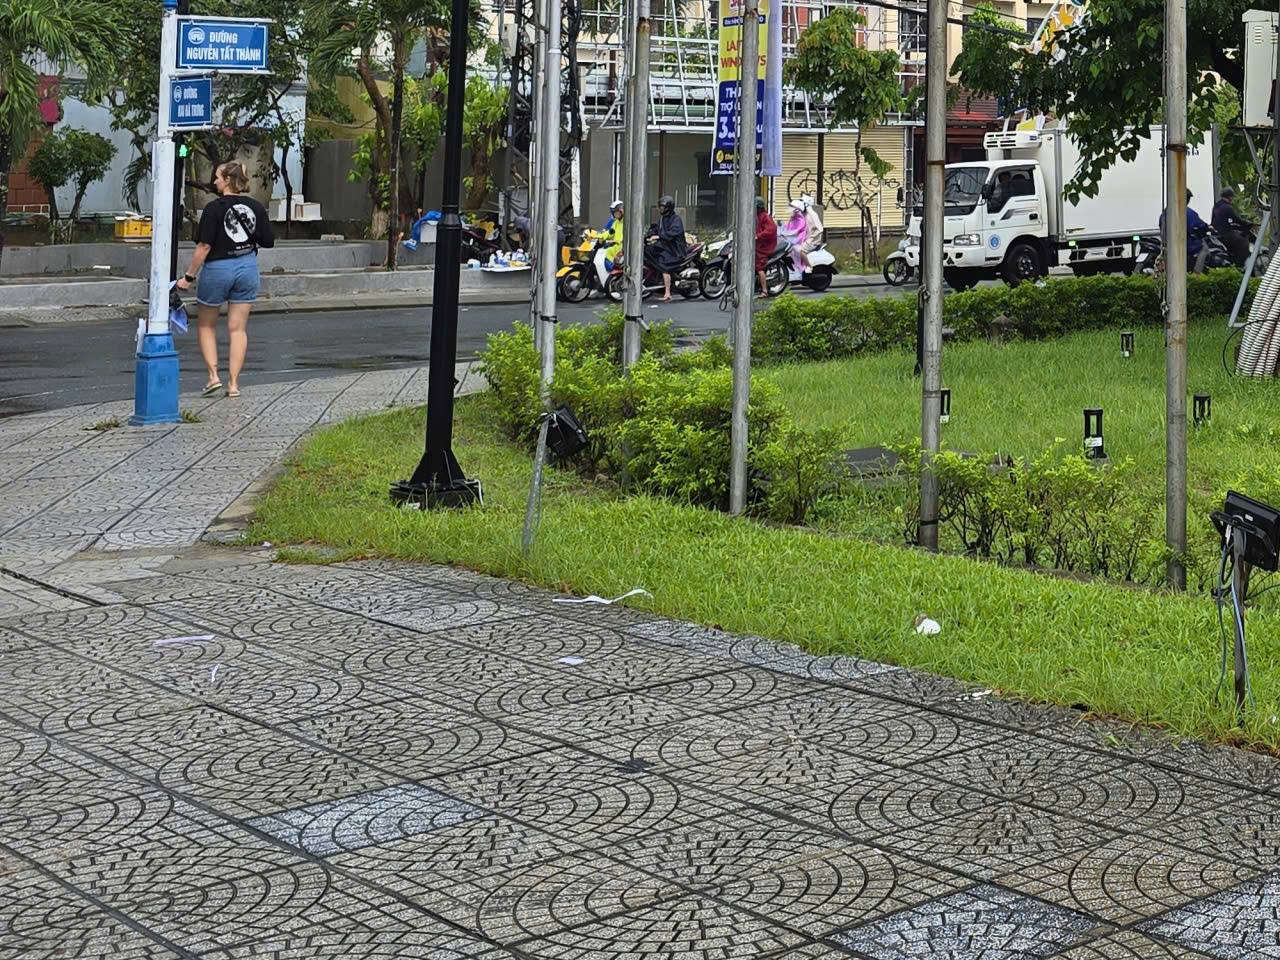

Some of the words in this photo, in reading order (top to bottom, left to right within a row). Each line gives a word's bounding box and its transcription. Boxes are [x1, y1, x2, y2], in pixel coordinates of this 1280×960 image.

[209, 30, 238, 44] ĐƯỜNG
[186, 44, 219, 60] NGUYỄN
[220, 45, 234, 60] TẤT
[236, 46, 261, 61] THÀNH
